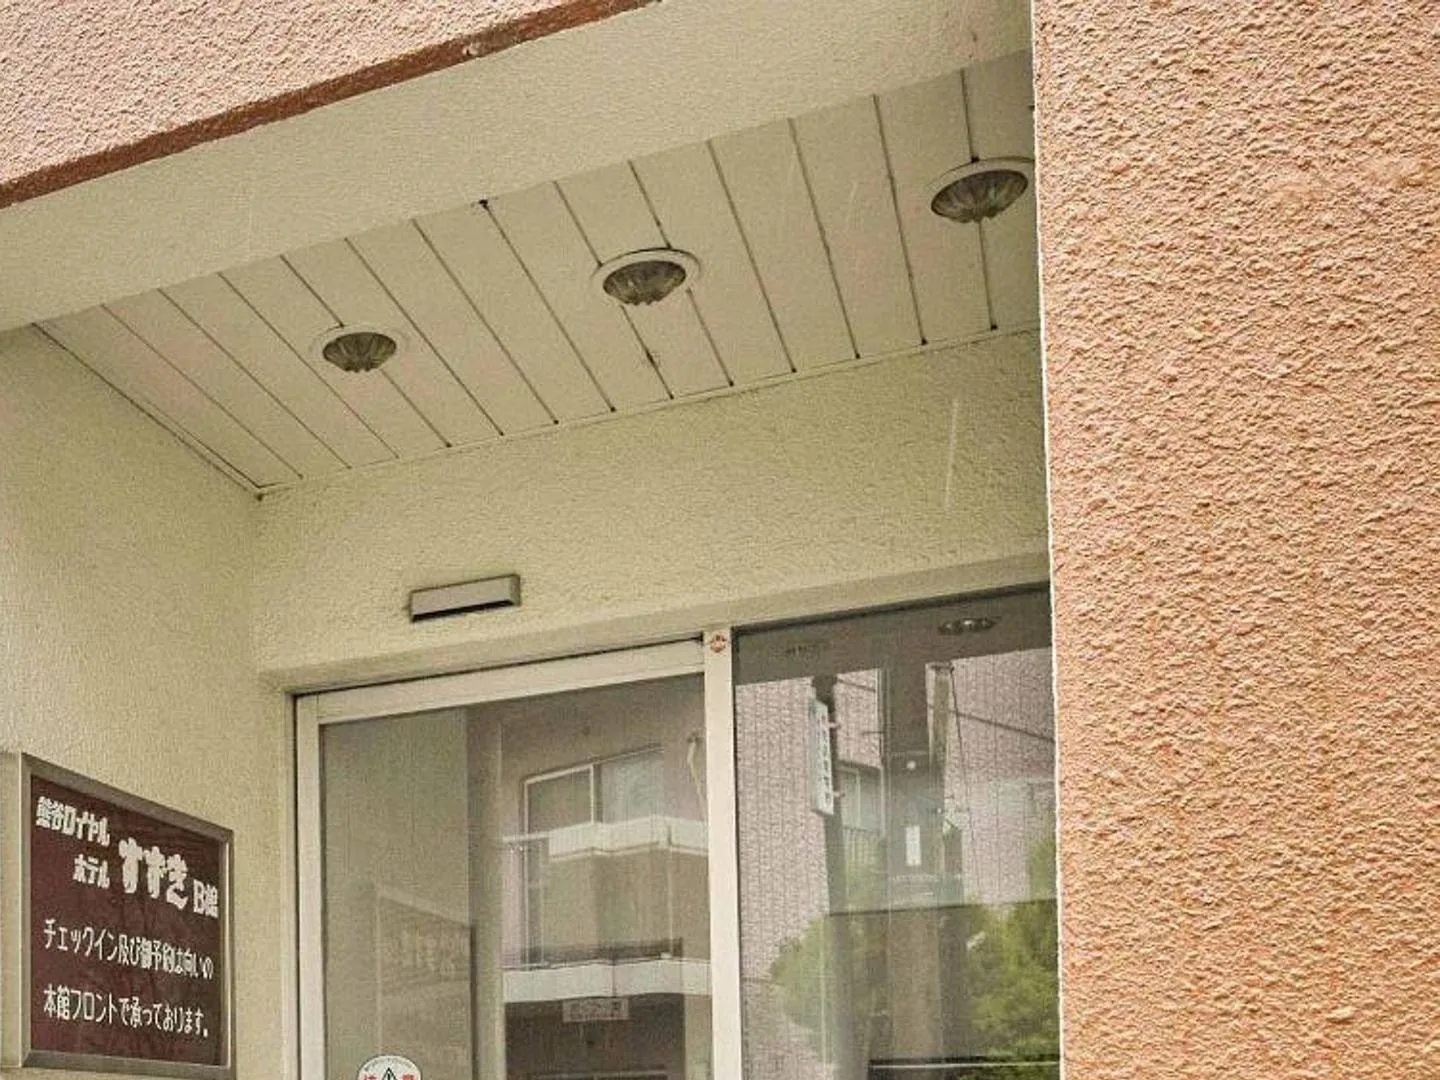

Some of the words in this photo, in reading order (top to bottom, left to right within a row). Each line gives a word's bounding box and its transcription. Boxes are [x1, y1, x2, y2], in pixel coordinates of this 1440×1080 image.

[72, 854, 110, 889] ホテル
[43, 983, 209, 1038] 本館フロントで承っております。
